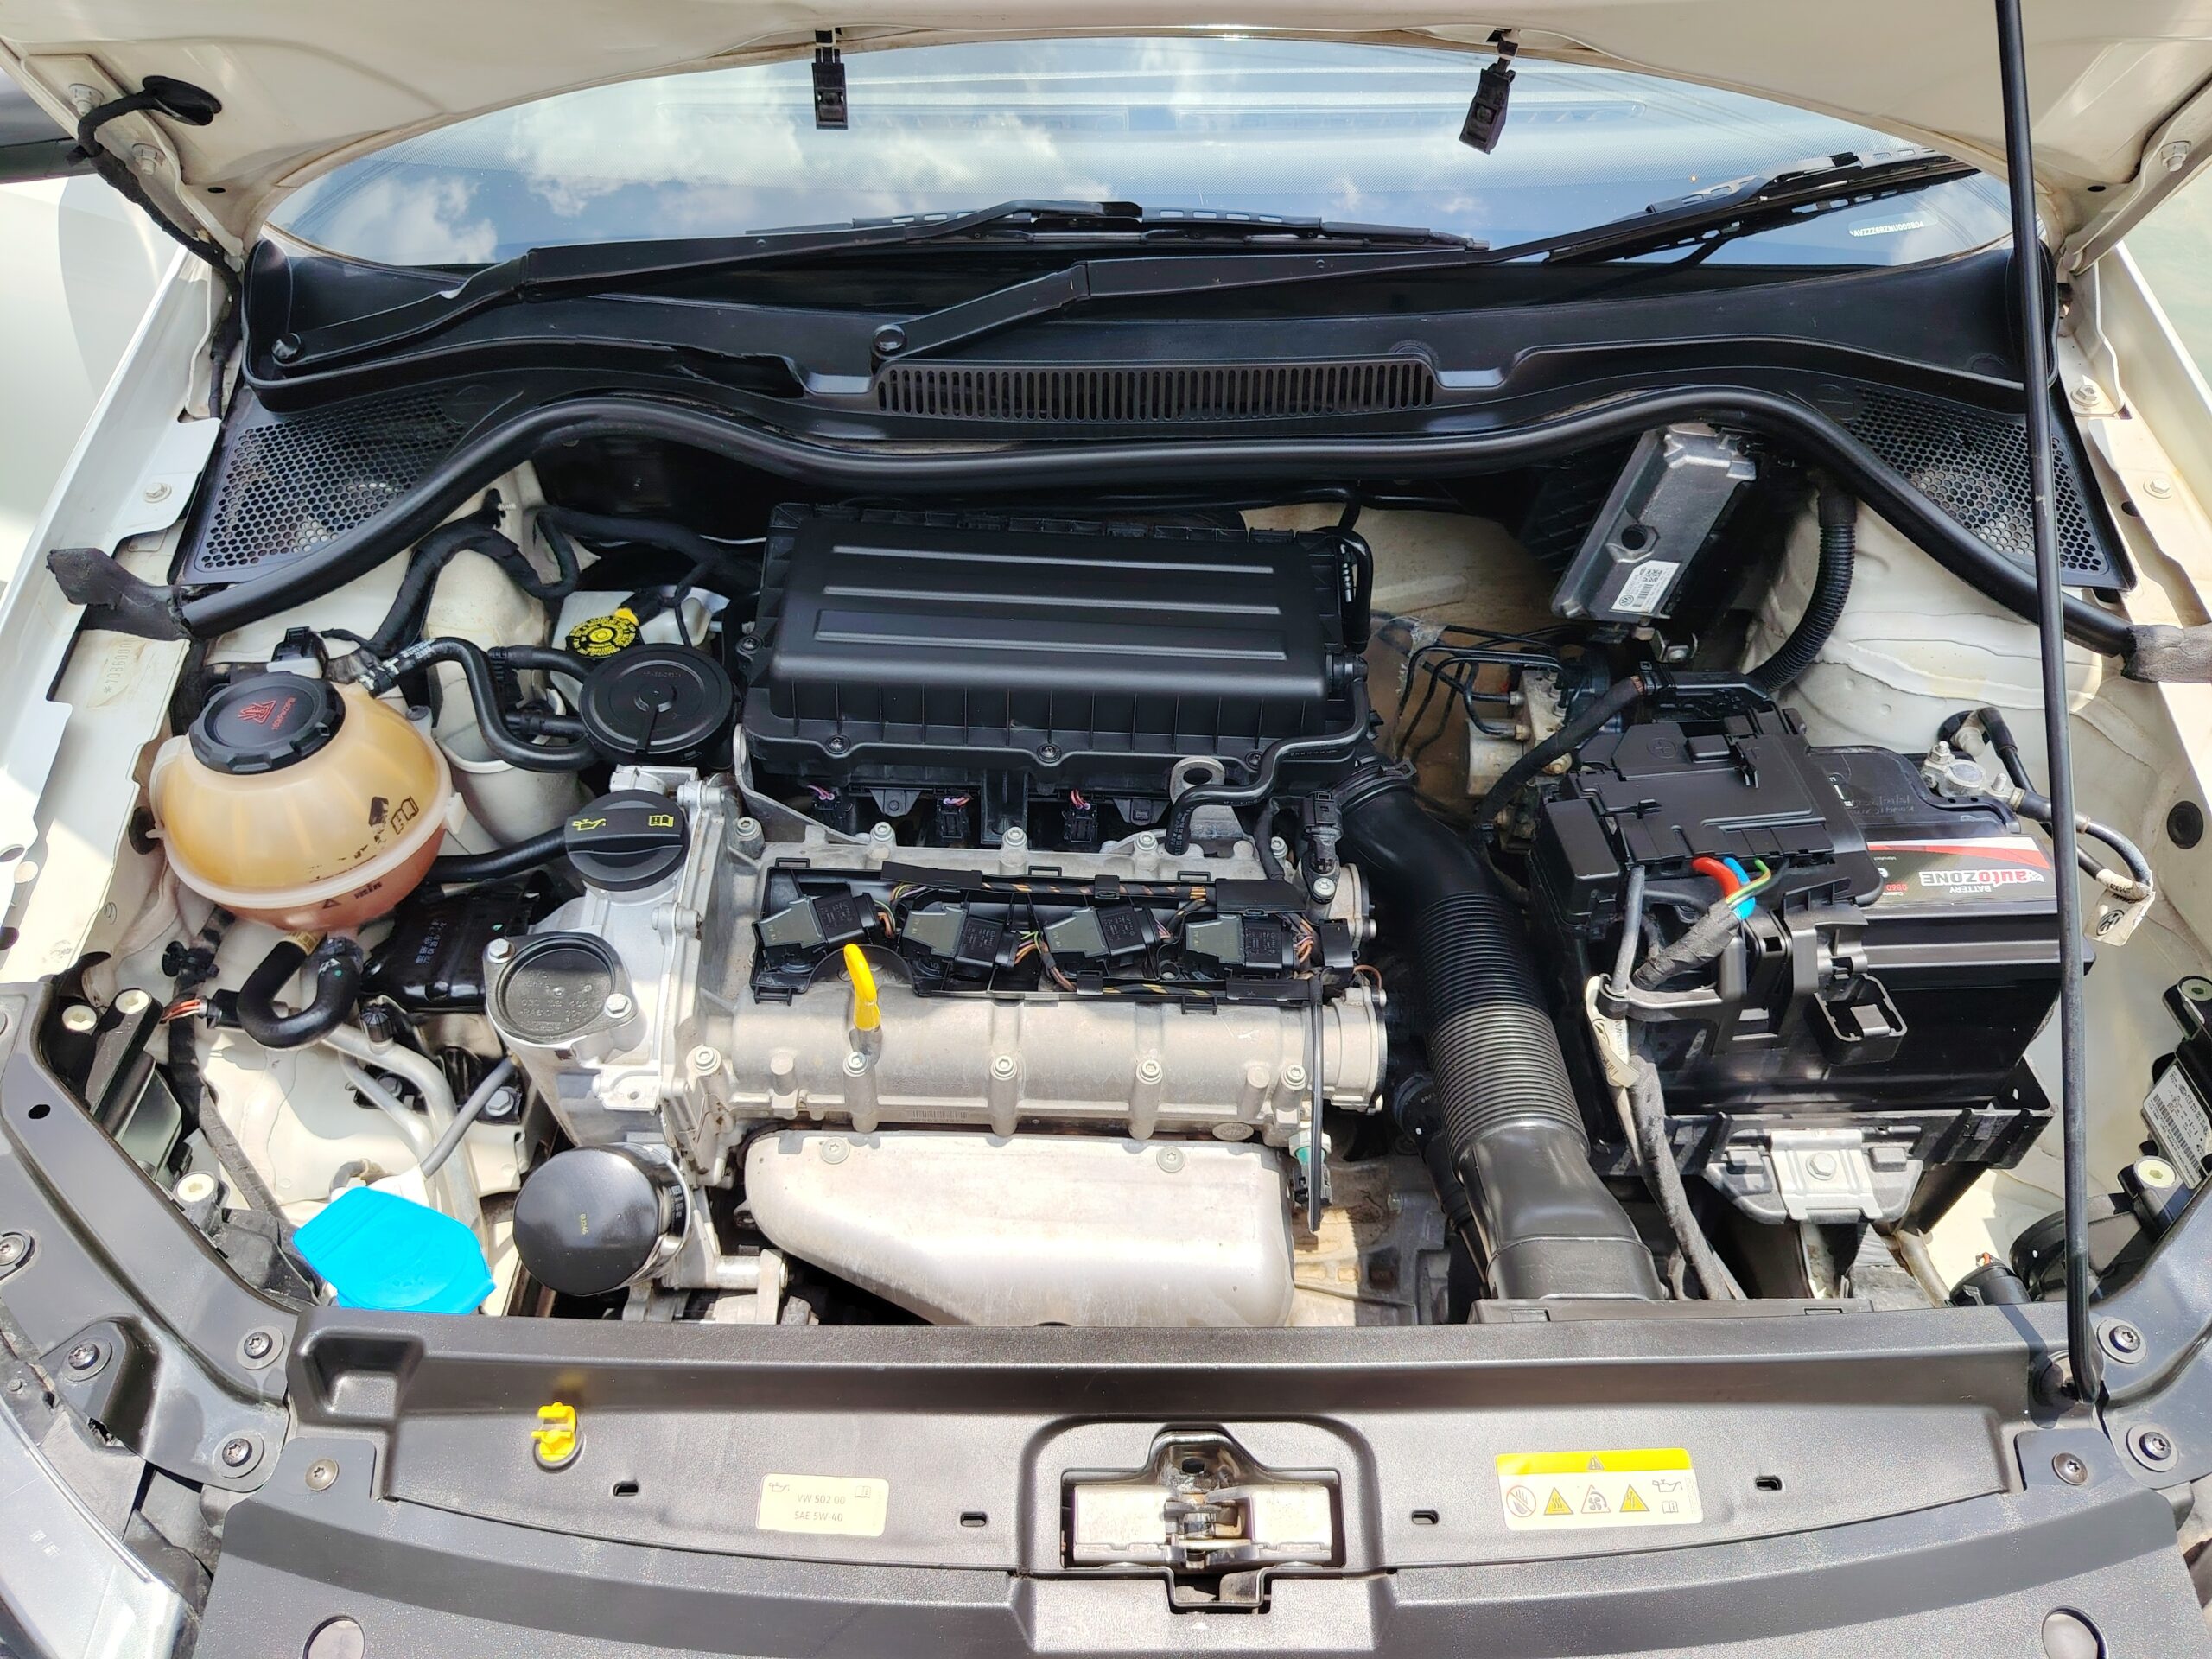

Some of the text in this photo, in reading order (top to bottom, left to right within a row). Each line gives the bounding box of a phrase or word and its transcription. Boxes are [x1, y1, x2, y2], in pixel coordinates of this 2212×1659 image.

[1922, 869, 2027, 885] autoZONE
[1949, 885, 1992, 893] BATTERY
[797, 1494, 846, 1505] VW 502 00
[794, 1510, 843, 1522] SAE 5W-40
